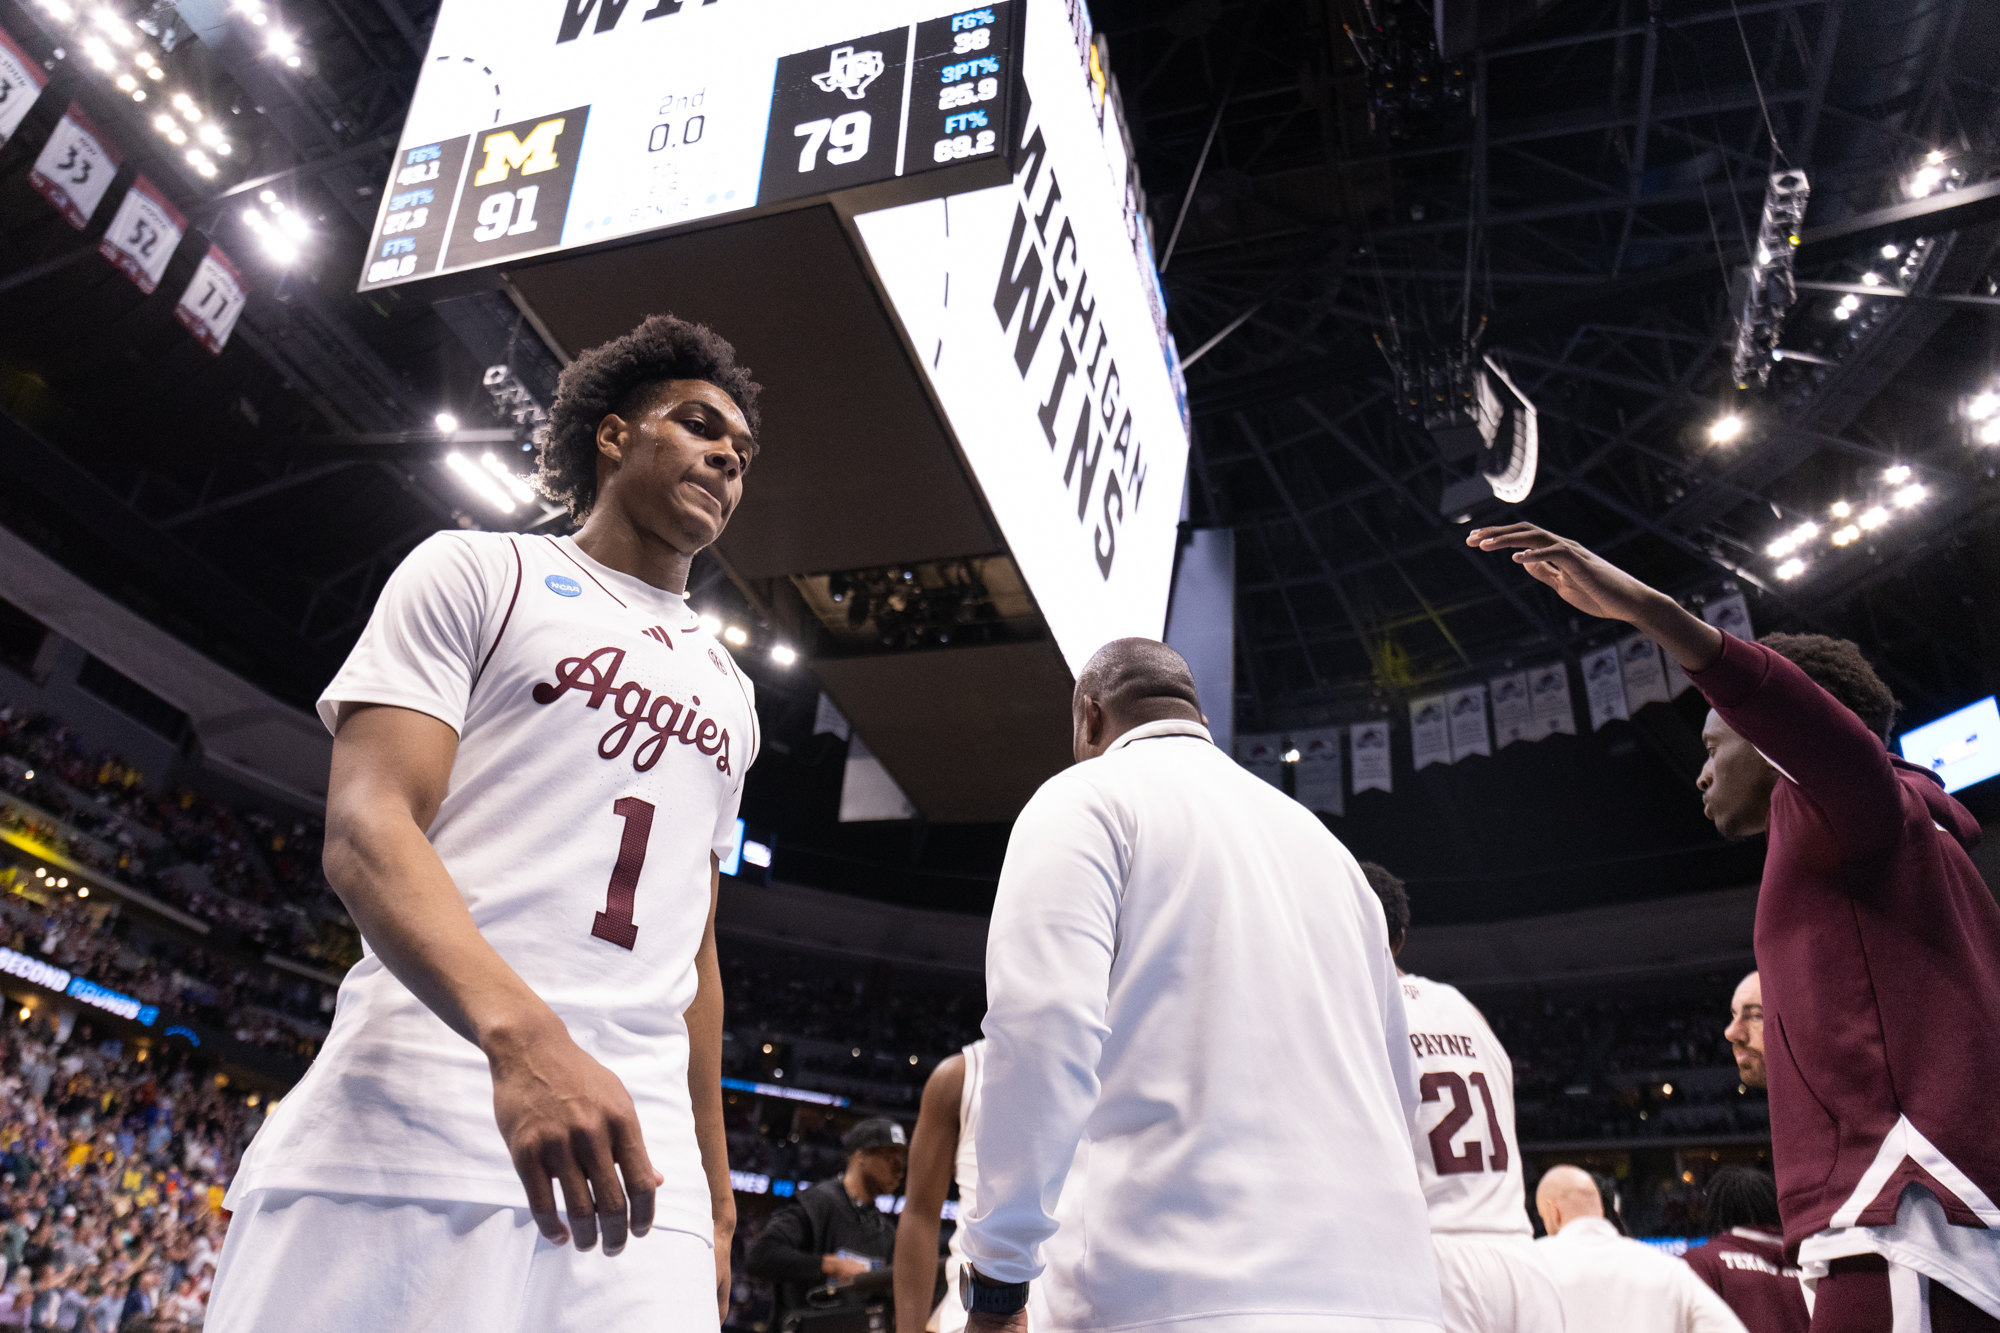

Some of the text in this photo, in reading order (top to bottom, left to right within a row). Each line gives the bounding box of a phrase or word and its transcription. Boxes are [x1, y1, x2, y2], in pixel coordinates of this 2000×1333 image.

[951, 8, 995, 31] FG%
[953, 28, 991, 54] 38
[940, 56, 999, 83] 3PT%
[938, 77, 998, 110] 25.9
[647, 114, 706, 153] 0.0
[944, 109, 989, 134] FT%
[473, 118, 566, 187] M
[794, 110, 872, 173] 79
[933, 130, 996, 163] 69.2
[473, 185, 540, 242] 91
[1014, 73, 1147, 513] MICHIGAN
[993, 200, 1123, 582] WINS
[550, 581, 581, 594] NCAA
[532, 646, 731, 776] Aggies
[591, 796, 656, 951] 1
[1410, 1033, 1476, 1059] PAYNE
[1420, 1071, 1509, 1176] 21
